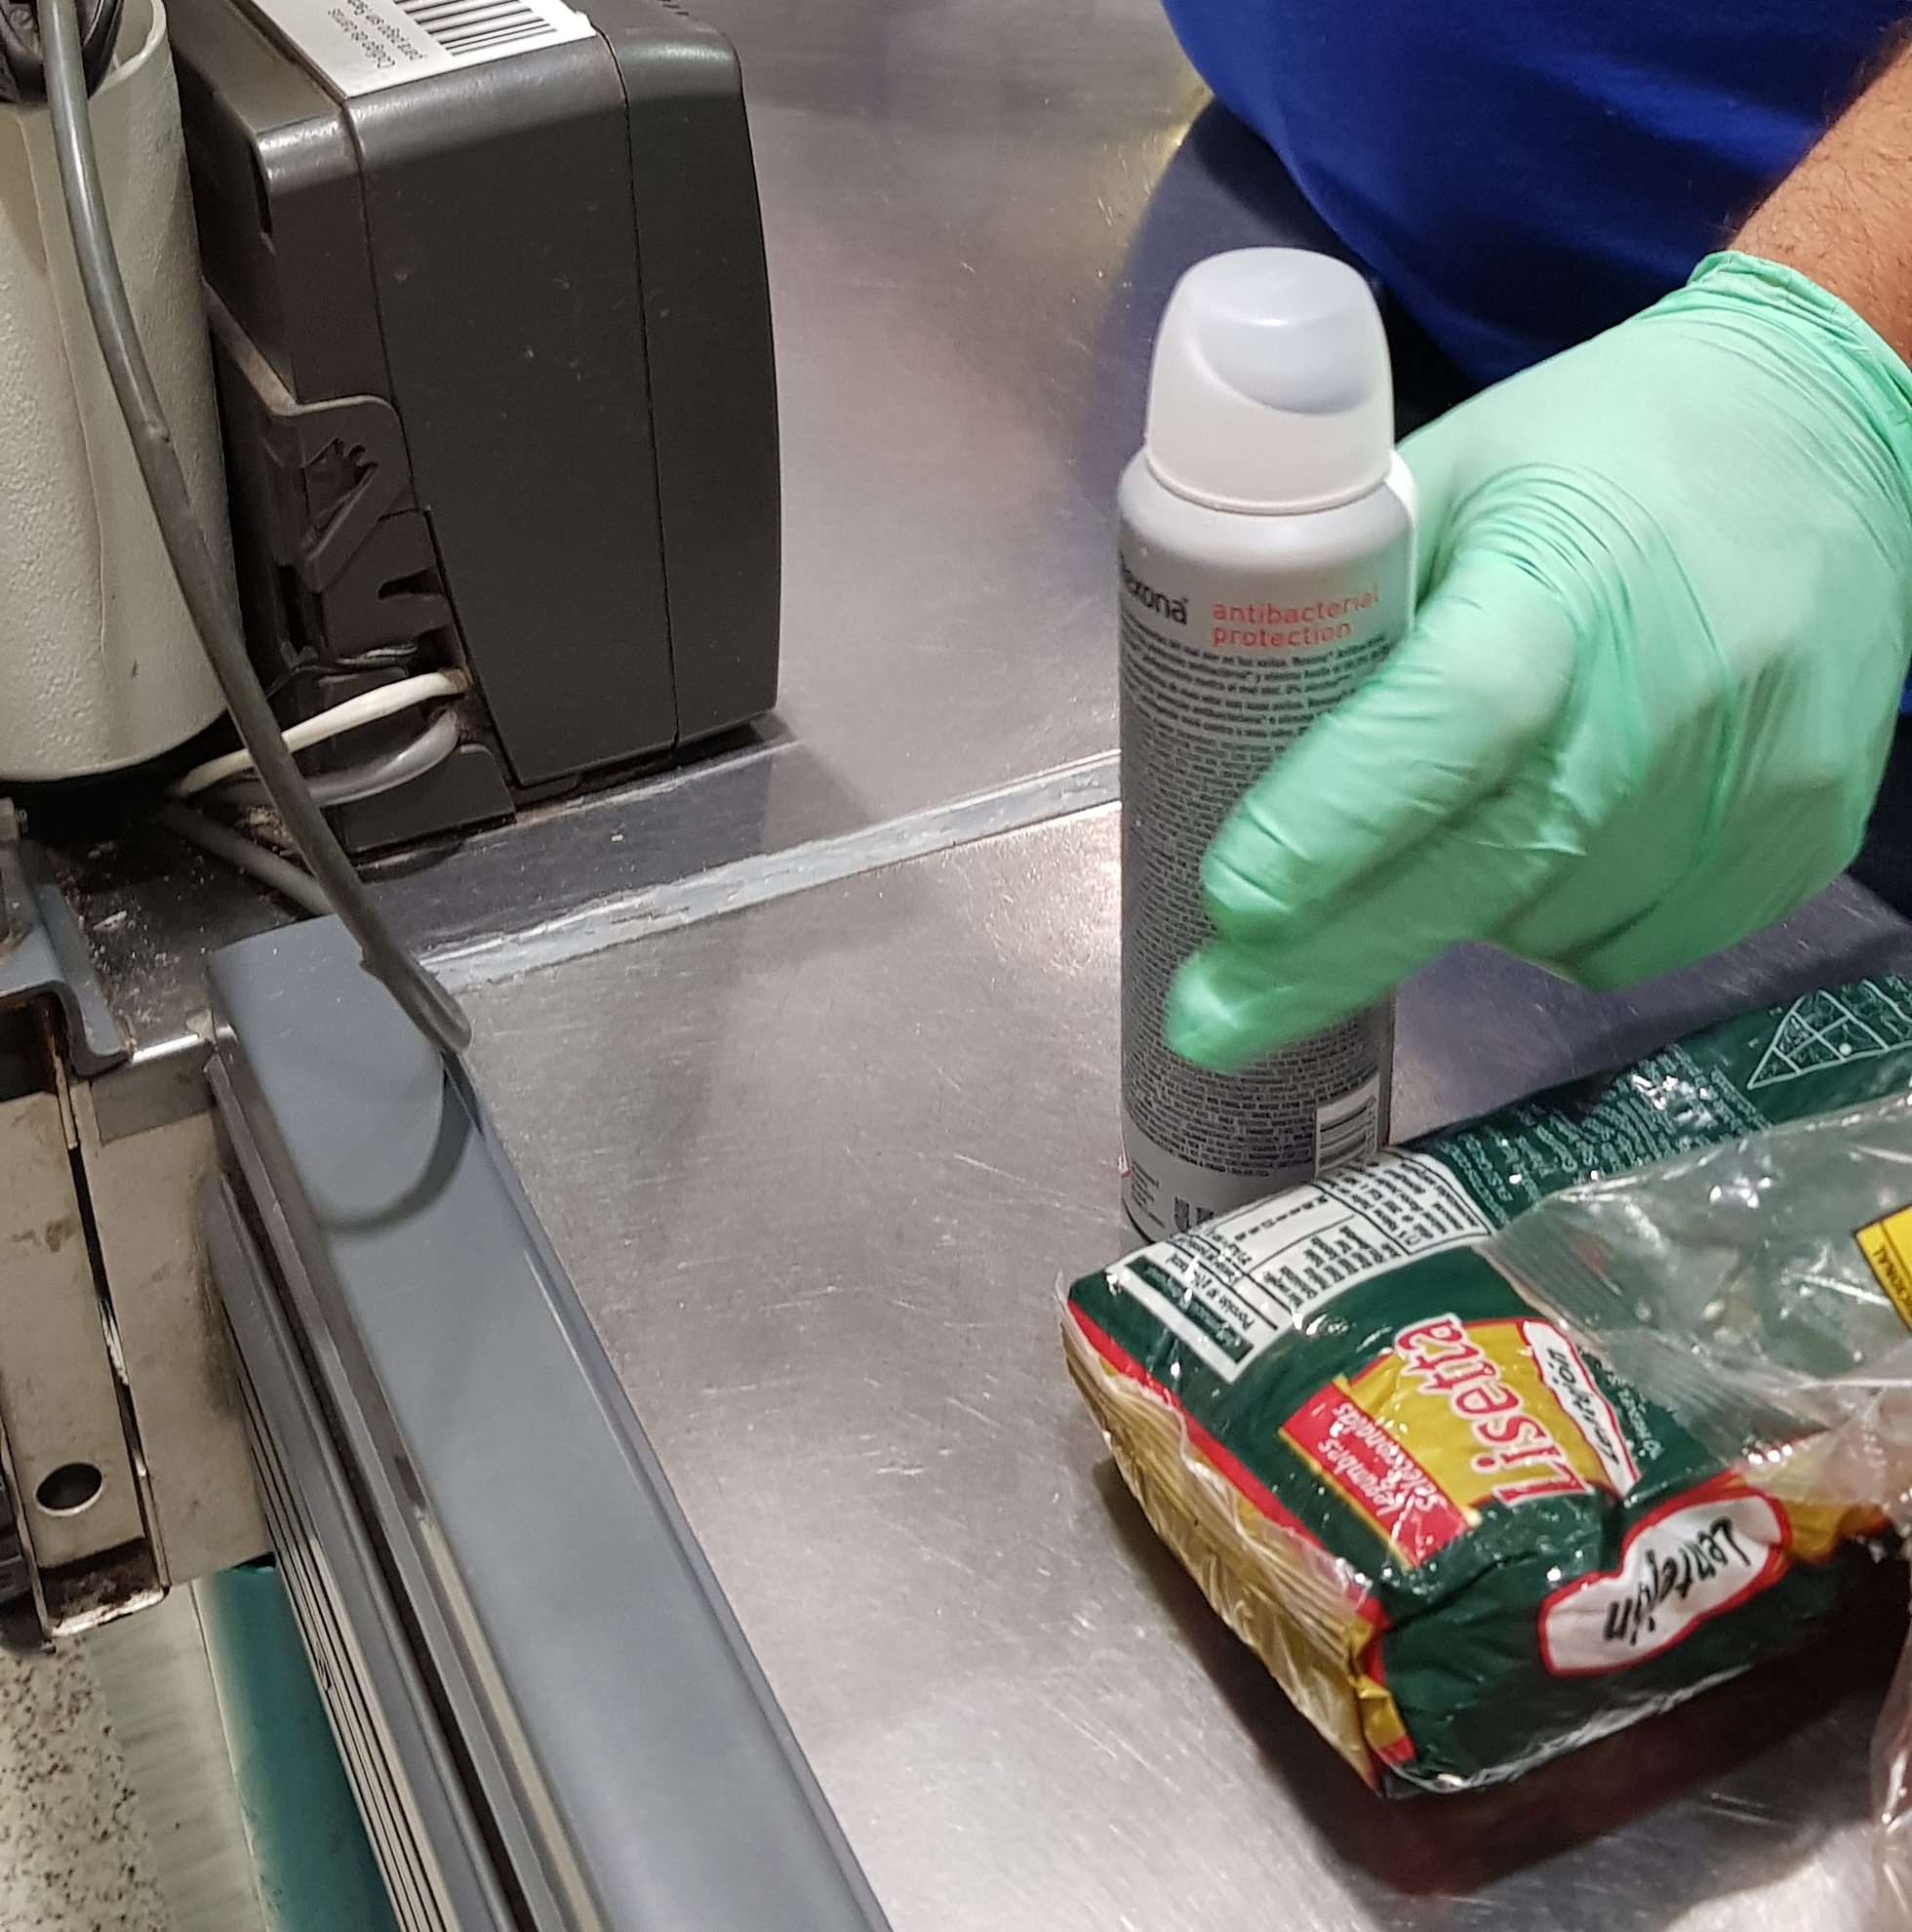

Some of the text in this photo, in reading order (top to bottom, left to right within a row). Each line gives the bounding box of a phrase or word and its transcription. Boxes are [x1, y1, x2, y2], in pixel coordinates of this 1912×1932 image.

[1213, 584, 1378, 624] antibacterial
[1213, 623, 1351, 648] protection
[1395, 1313, 1595, 1507] Lisetta
